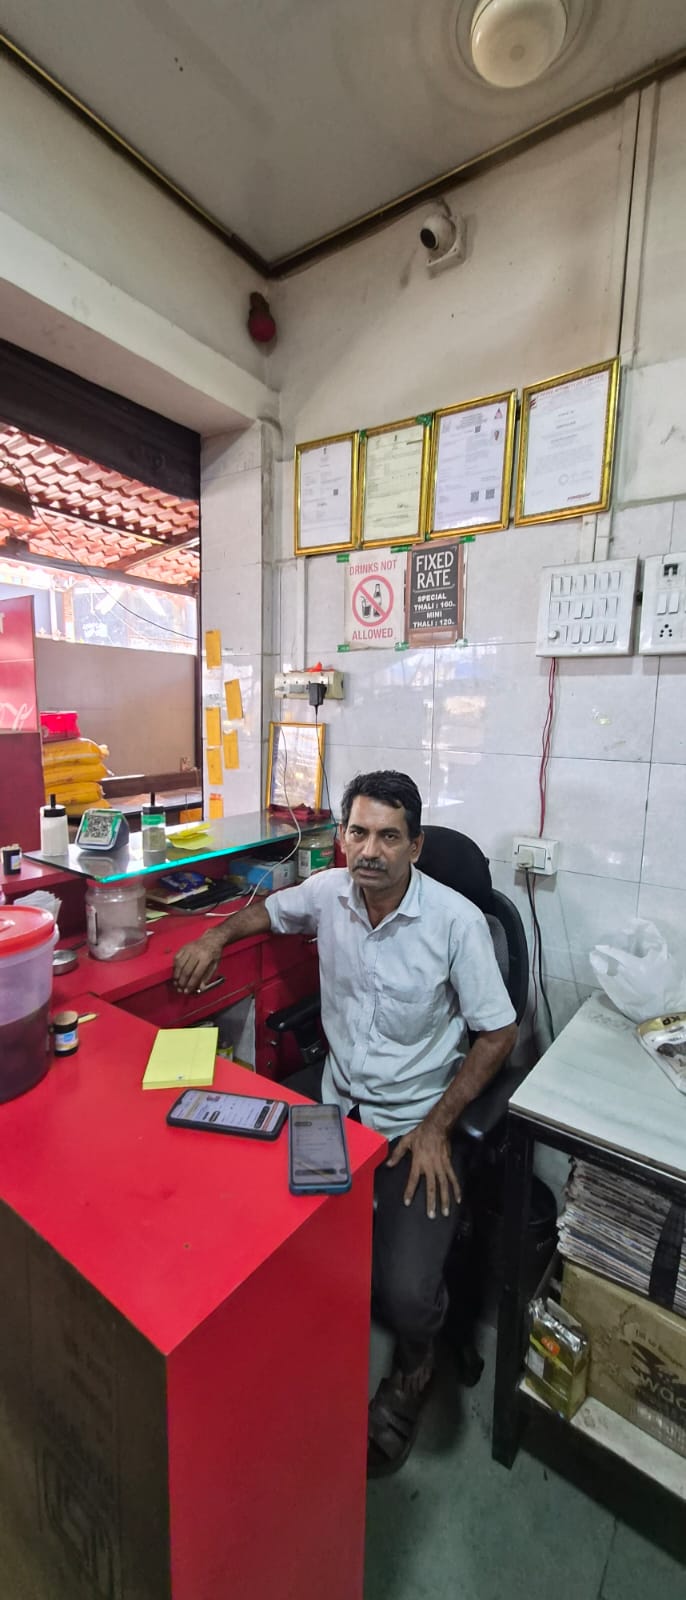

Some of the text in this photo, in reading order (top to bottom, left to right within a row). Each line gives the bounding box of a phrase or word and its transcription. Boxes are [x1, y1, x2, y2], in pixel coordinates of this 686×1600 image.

[416, 551, 454, 572] FIXED
[349, 560, 397, 575] DRINKS NOT
[417, 569, 451, 589] RATE
[417, 593, 447, 602] SPECIAL
[414, 602, 434, 611] THALI
[426, 611, 442, 619] MINI
[413, 621, 433, 629] THALI
[352, 628, 393, 640] ALLOWED
